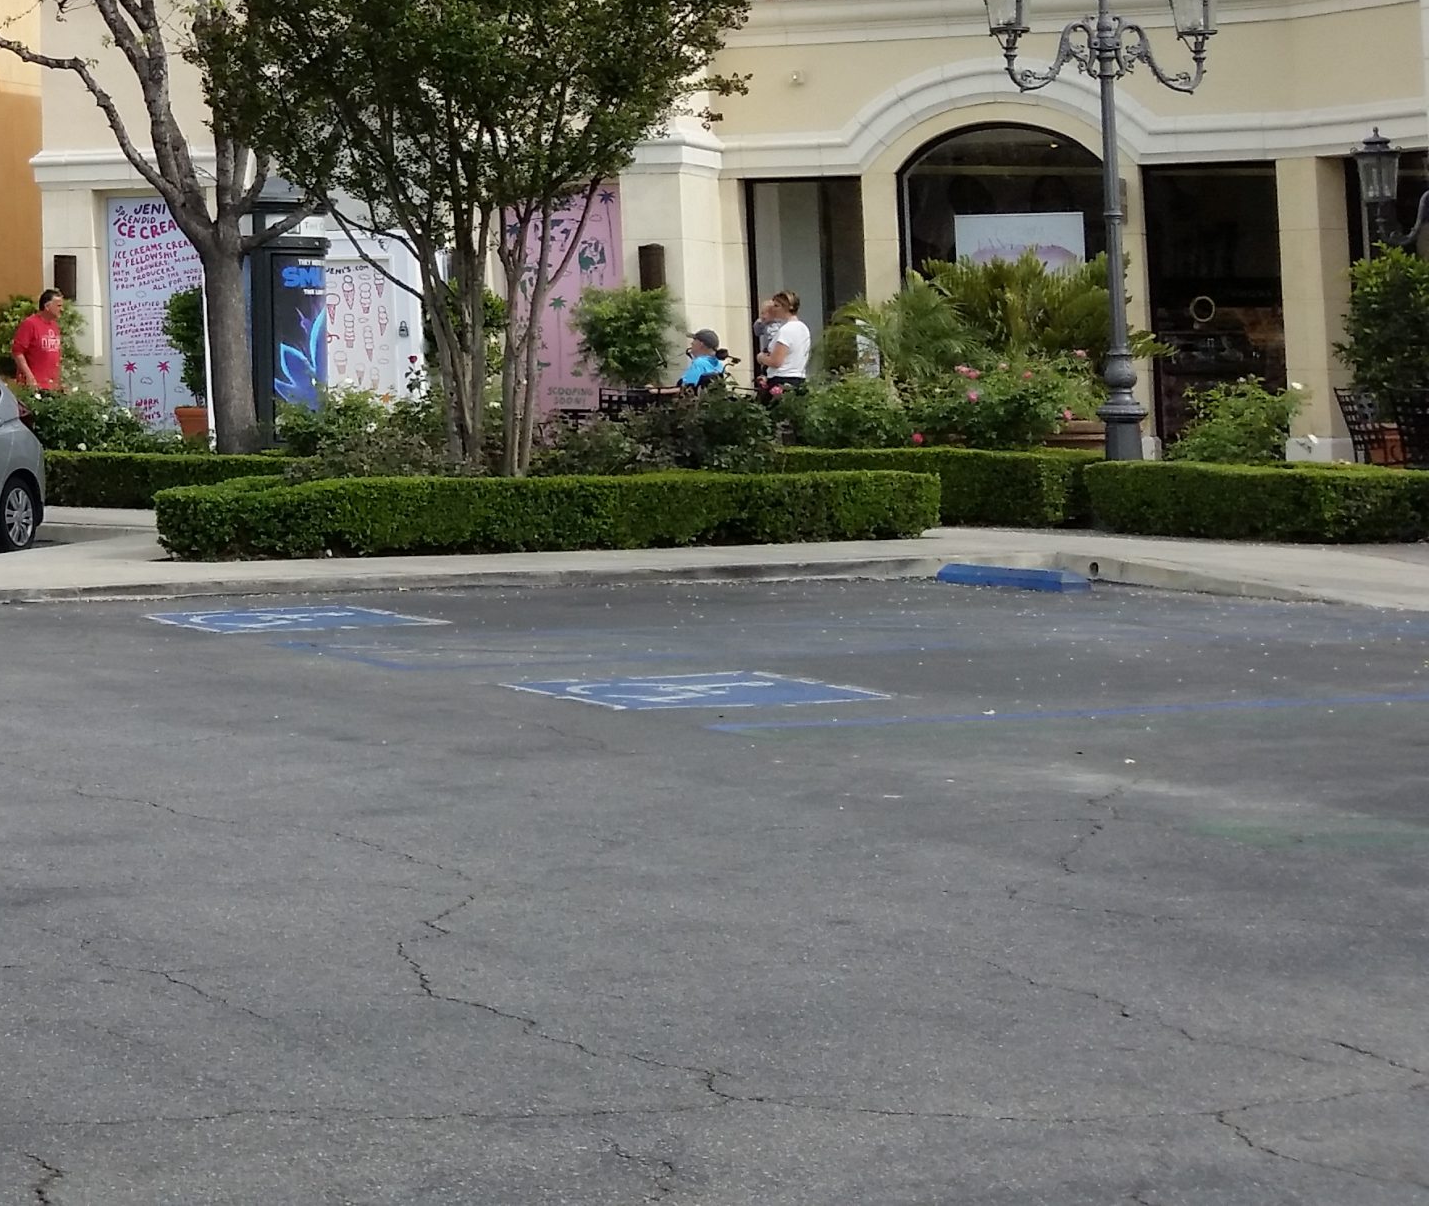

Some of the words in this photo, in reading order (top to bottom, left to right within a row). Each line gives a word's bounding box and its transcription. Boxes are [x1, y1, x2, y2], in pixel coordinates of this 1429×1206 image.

[134, 203, 166, 215] JENI
[113, 218, 136, 239] ICE
[139, 219, 177, 240] CREA
[114, 250, 127, 260] ICE
[129, 242, 163, 257] CREAMS
[112, 260, 121, 268] IN
